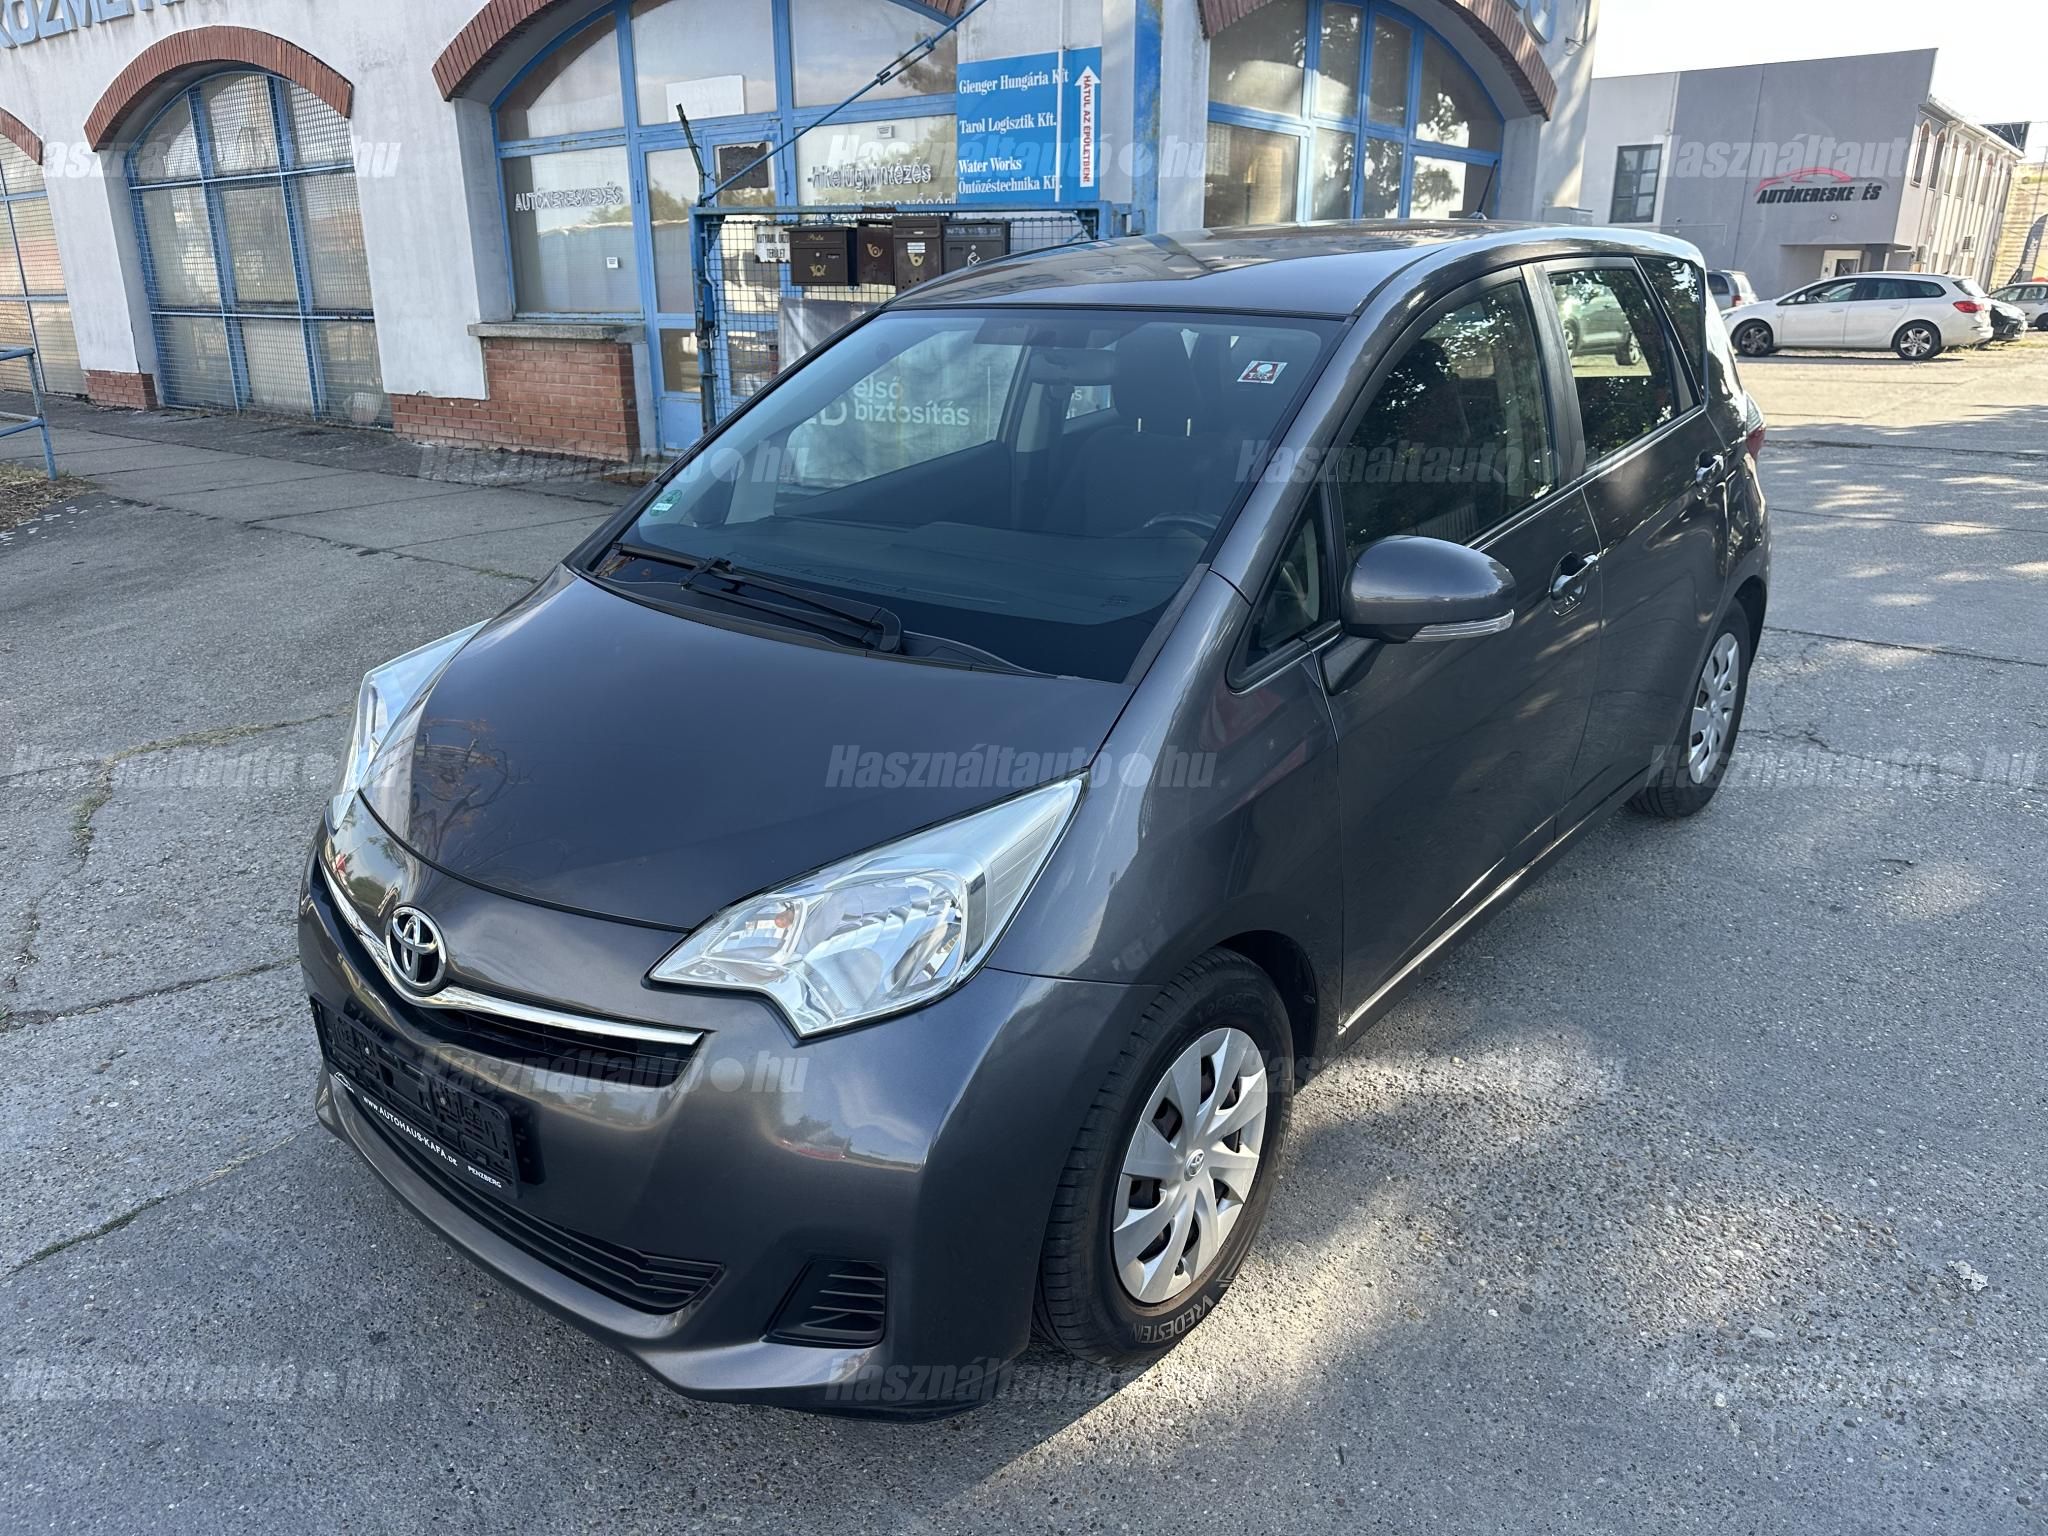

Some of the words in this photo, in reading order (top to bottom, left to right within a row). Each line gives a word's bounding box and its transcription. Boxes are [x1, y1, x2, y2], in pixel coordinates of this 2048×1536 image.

[959, 80, 998, 95] Gienger
[1000, 71, 1049, 91] Hungária
[959, 119, 986, 134] Tarol
[988, 115, 1035, 135] Logisztik
[1037, 112, 1057, 126] Kft.
[958, 159, 988, 173] Water
[990, 156, 1022, 170] Works
[958, 177, 1040, 194] Öntözéstechnika
[854, 399, 971, 426] biztosítás
[1131, 1294, 1215, 1345] VREDESTEIN
